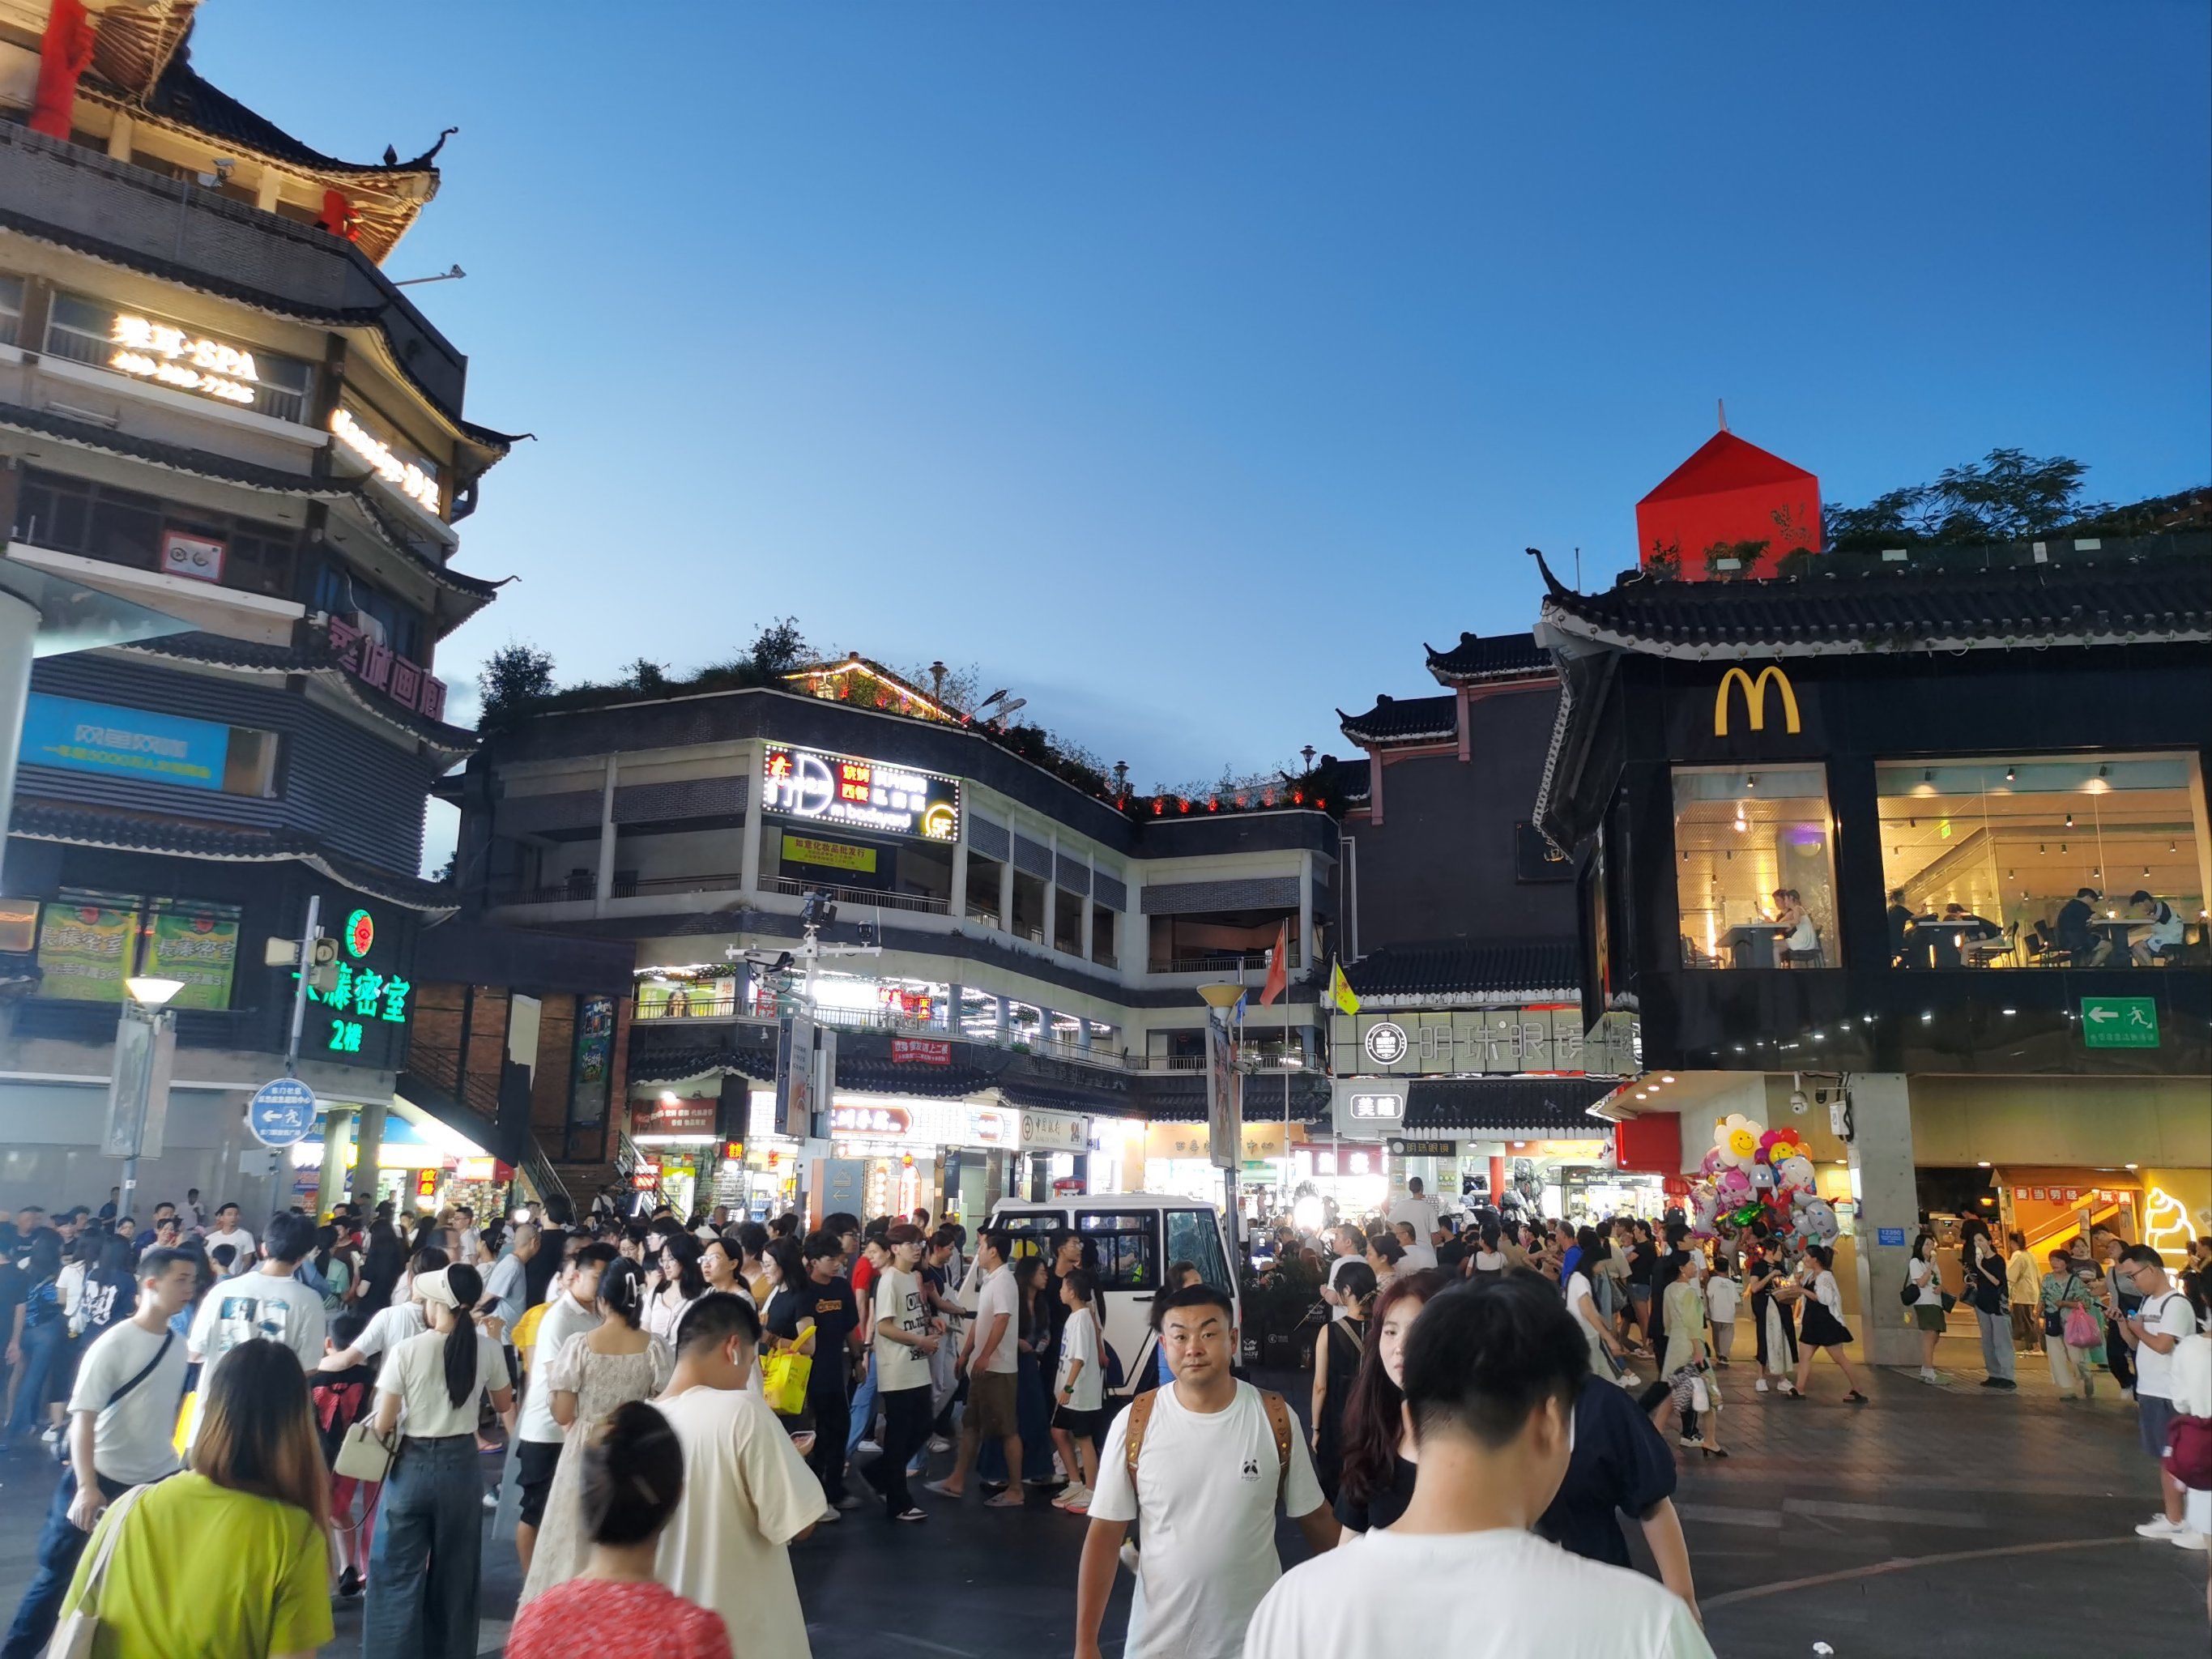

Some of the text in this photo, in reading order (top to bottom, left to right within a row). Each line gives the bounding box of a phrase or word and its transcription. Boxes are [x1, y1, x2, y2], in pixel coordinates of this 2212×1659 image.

[842, 783, 869, 802] 西餐
[1406, 1142, 1450, 1153] 明珠眼镜
